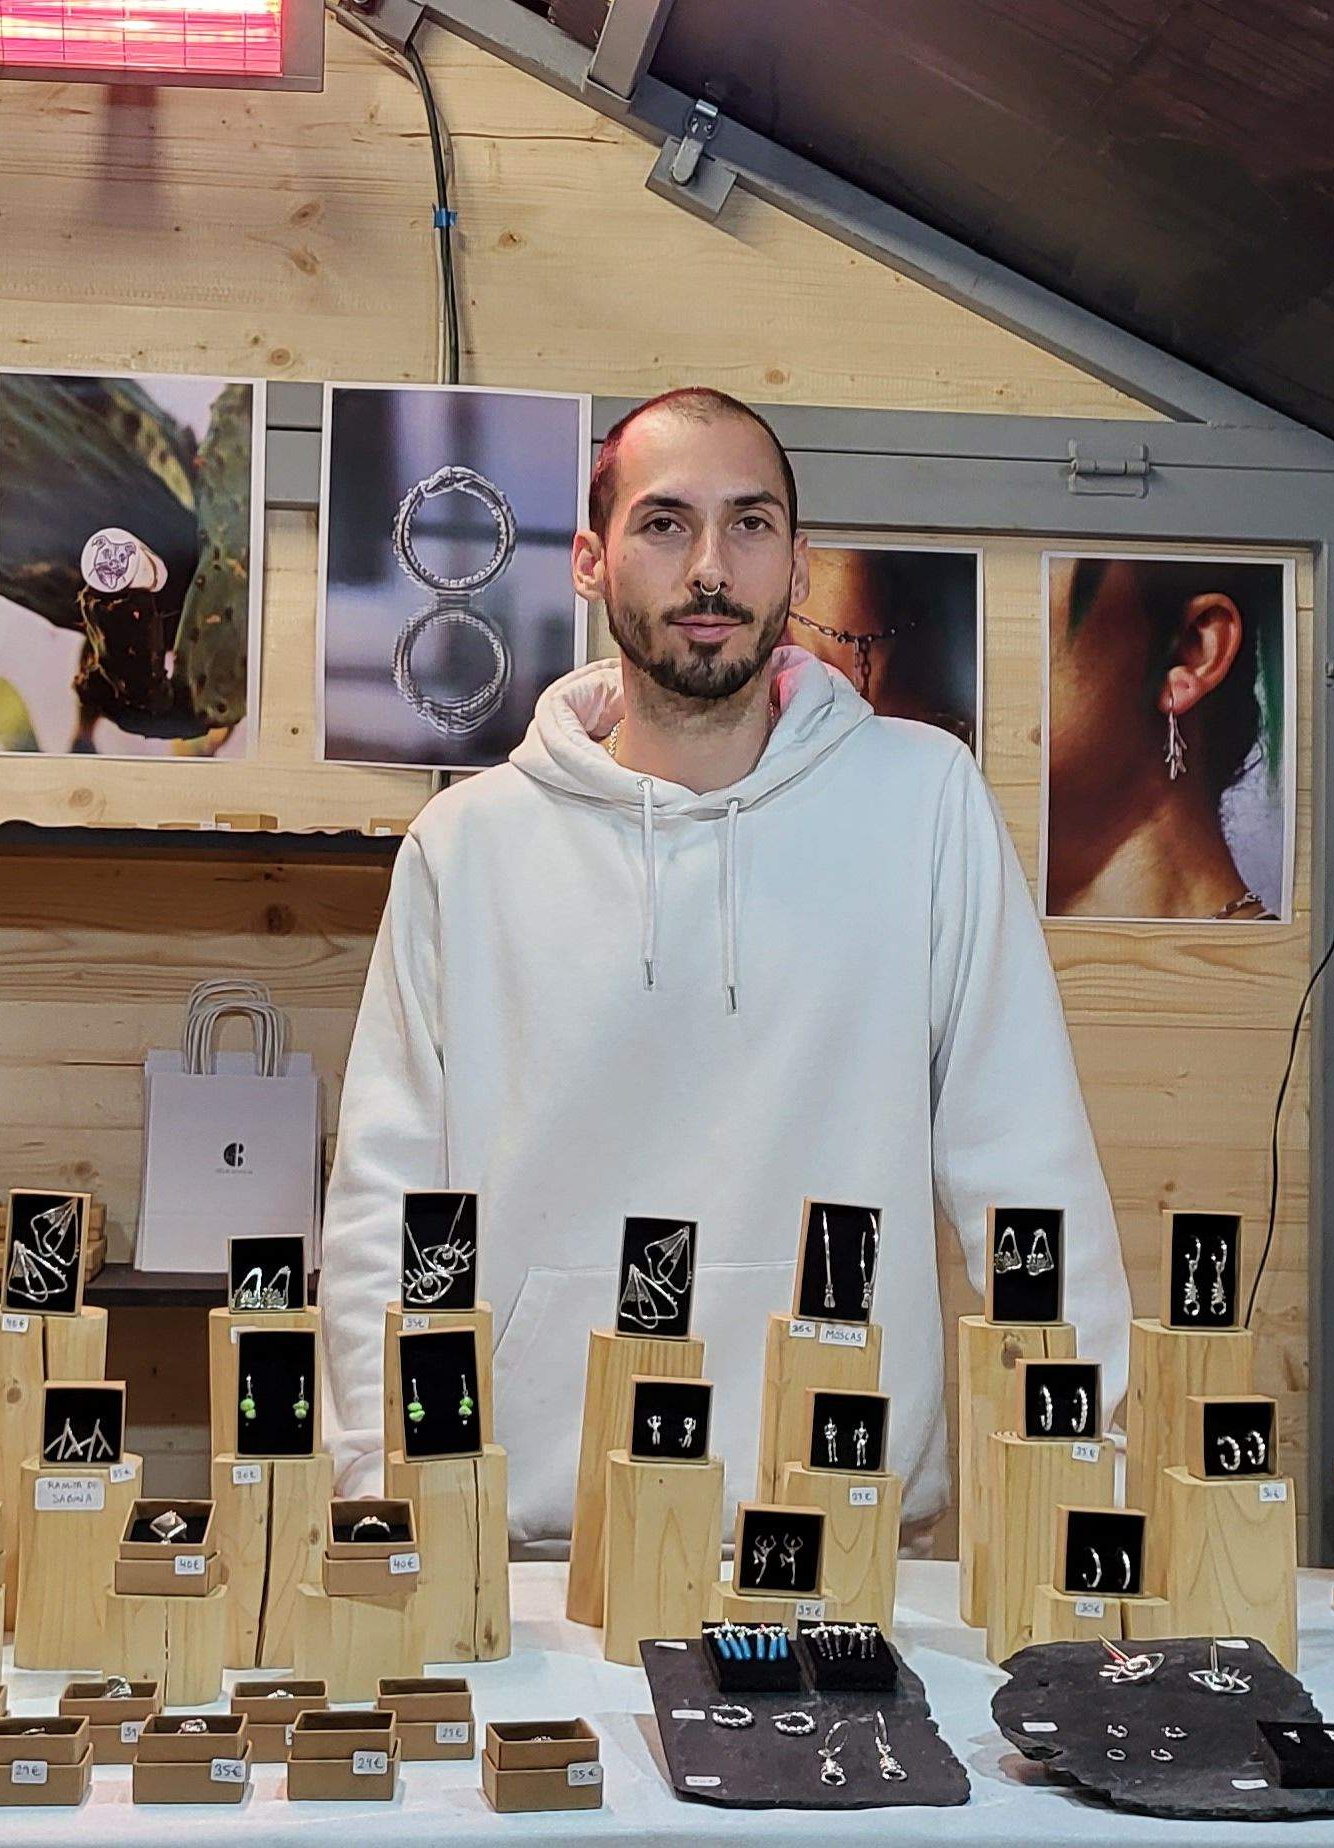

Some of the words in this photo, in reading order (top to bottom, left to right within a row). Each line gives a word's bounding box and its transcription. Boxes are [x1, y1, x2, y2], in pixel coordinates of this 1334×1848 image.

[826, 1330, 863, 1343] MOSCAS
[180, 1559, 199, 1571] 40€
[393, 1558, 414, 1570] 40€
[214, 1762, 243, 1778] 35€
